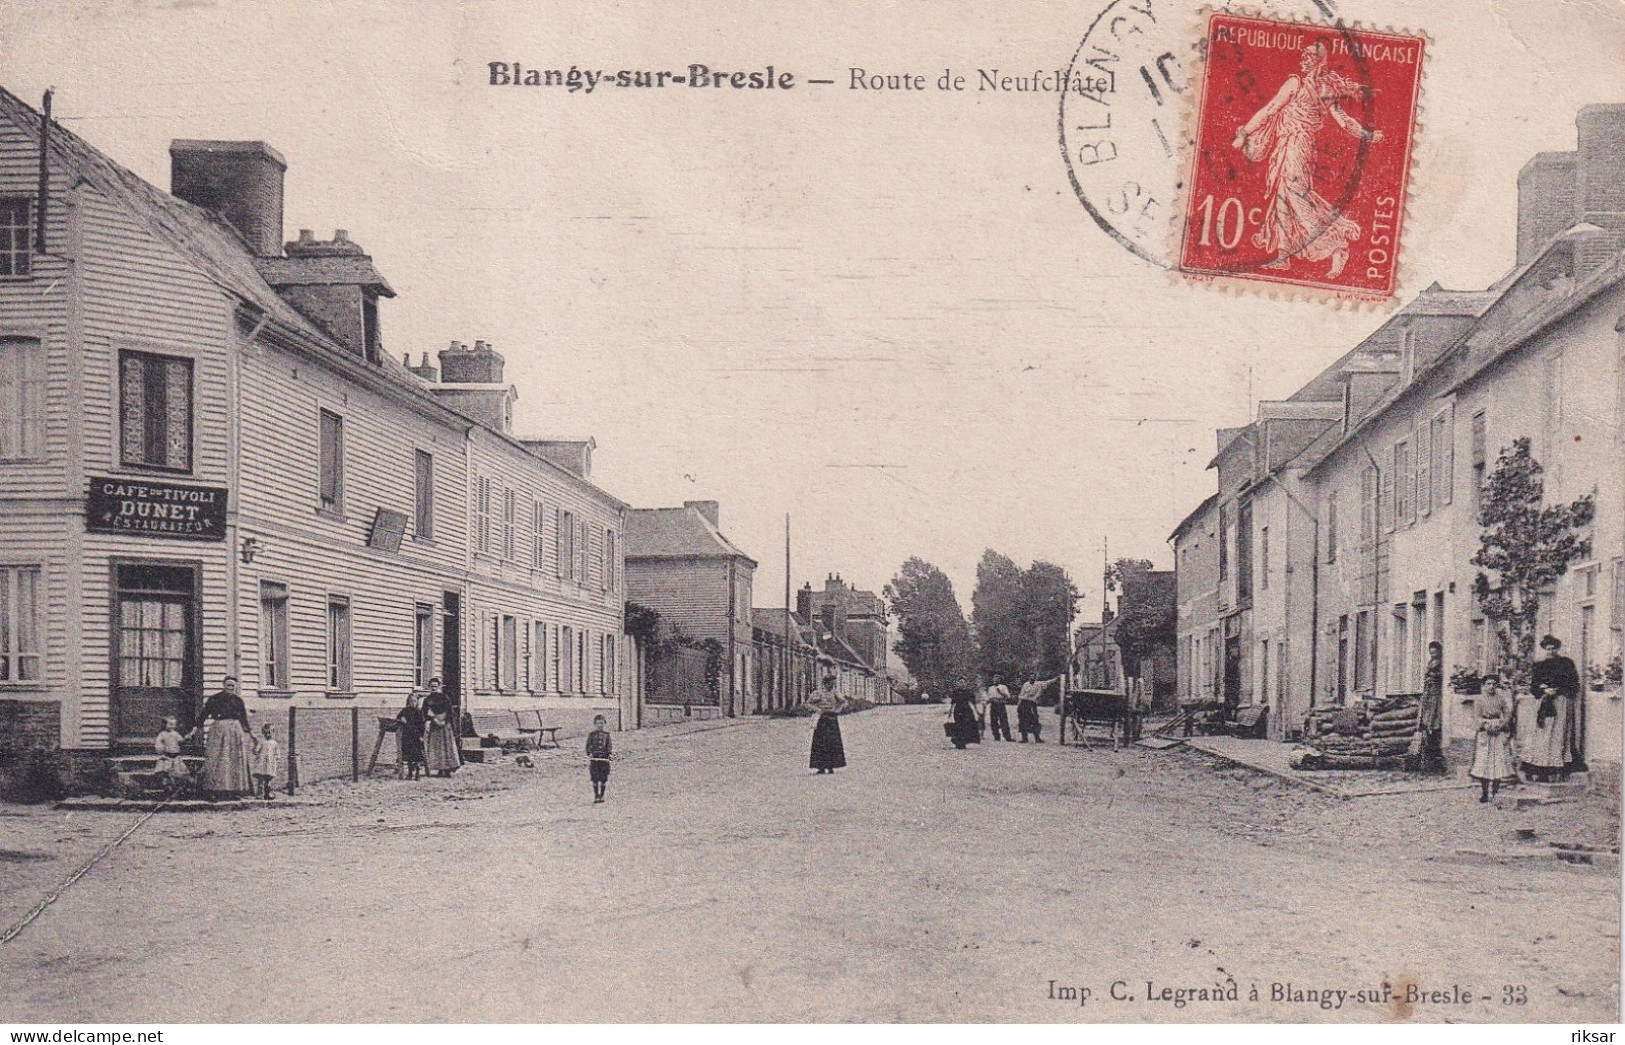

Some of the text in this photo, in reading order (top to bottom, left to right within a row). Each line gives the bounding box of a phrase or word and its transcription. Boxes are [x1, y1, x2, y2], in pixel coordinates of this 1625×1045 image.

[1331, 38, 1415, 65] FRANÇAISE
[1366, 196, 1396, 279] POSTES
[163, 488, 215, 503] TIVOLI
[120, 500, 200, 521] DUNET
